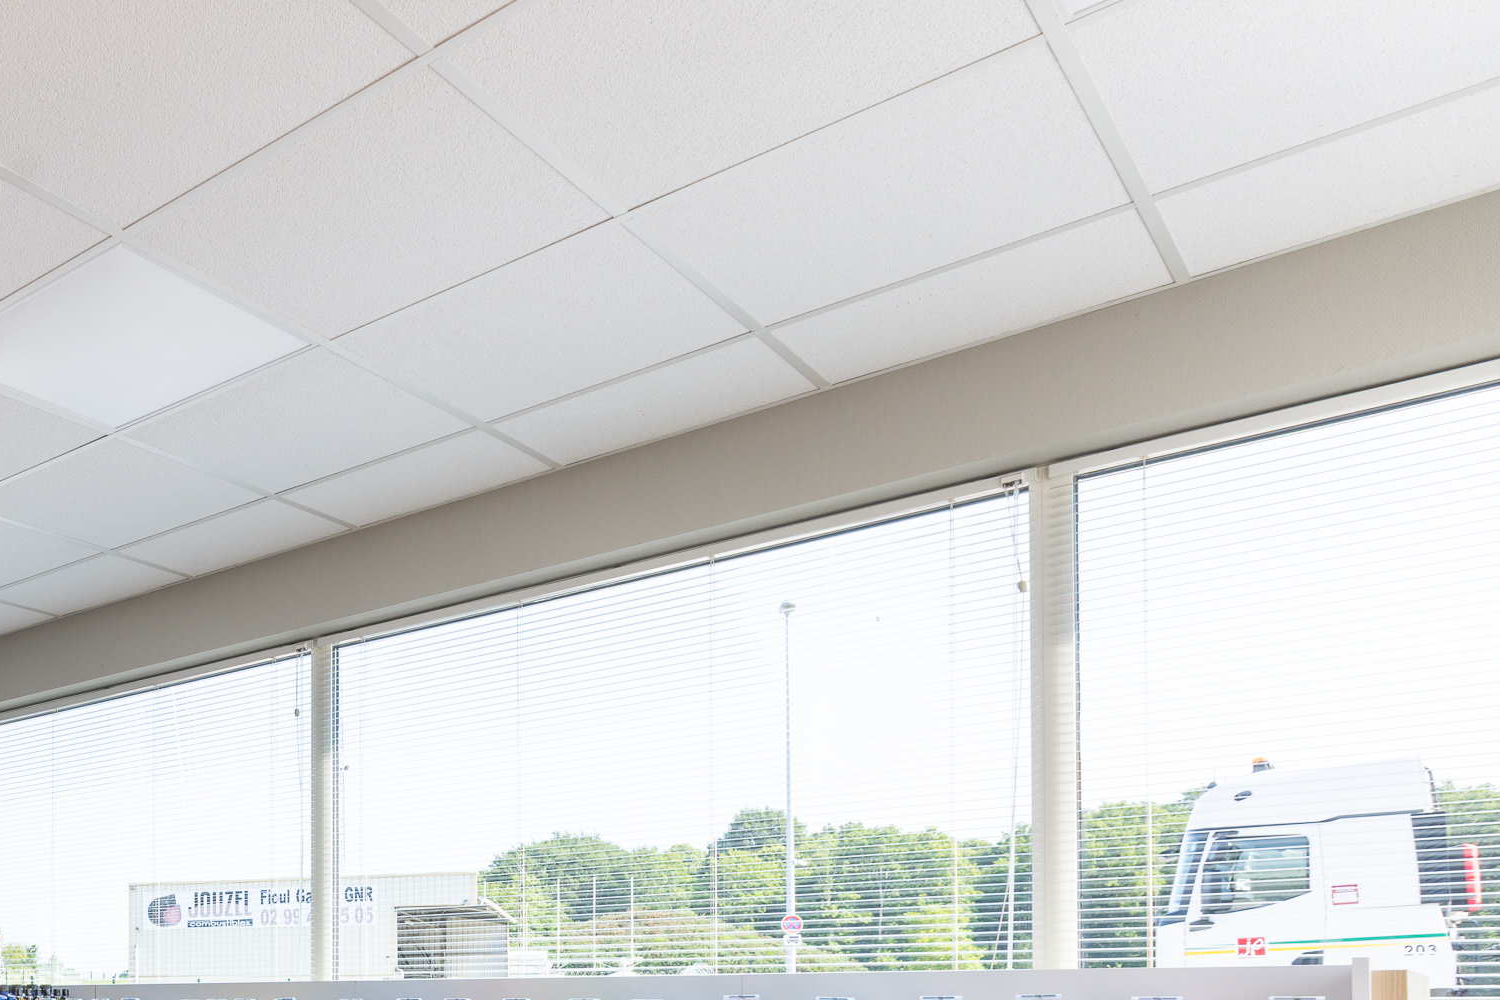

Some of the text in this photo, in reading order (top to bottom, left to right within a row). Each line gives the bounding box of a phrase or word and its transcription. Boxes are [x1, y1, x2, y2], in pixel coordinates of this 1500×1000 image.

[188, 890, 252, 918] JOUZEL
[344, 886, 374, 902] GNR
[189, 919, 253, 928] combustibles
[1404, 944, 1437, 956] 203
